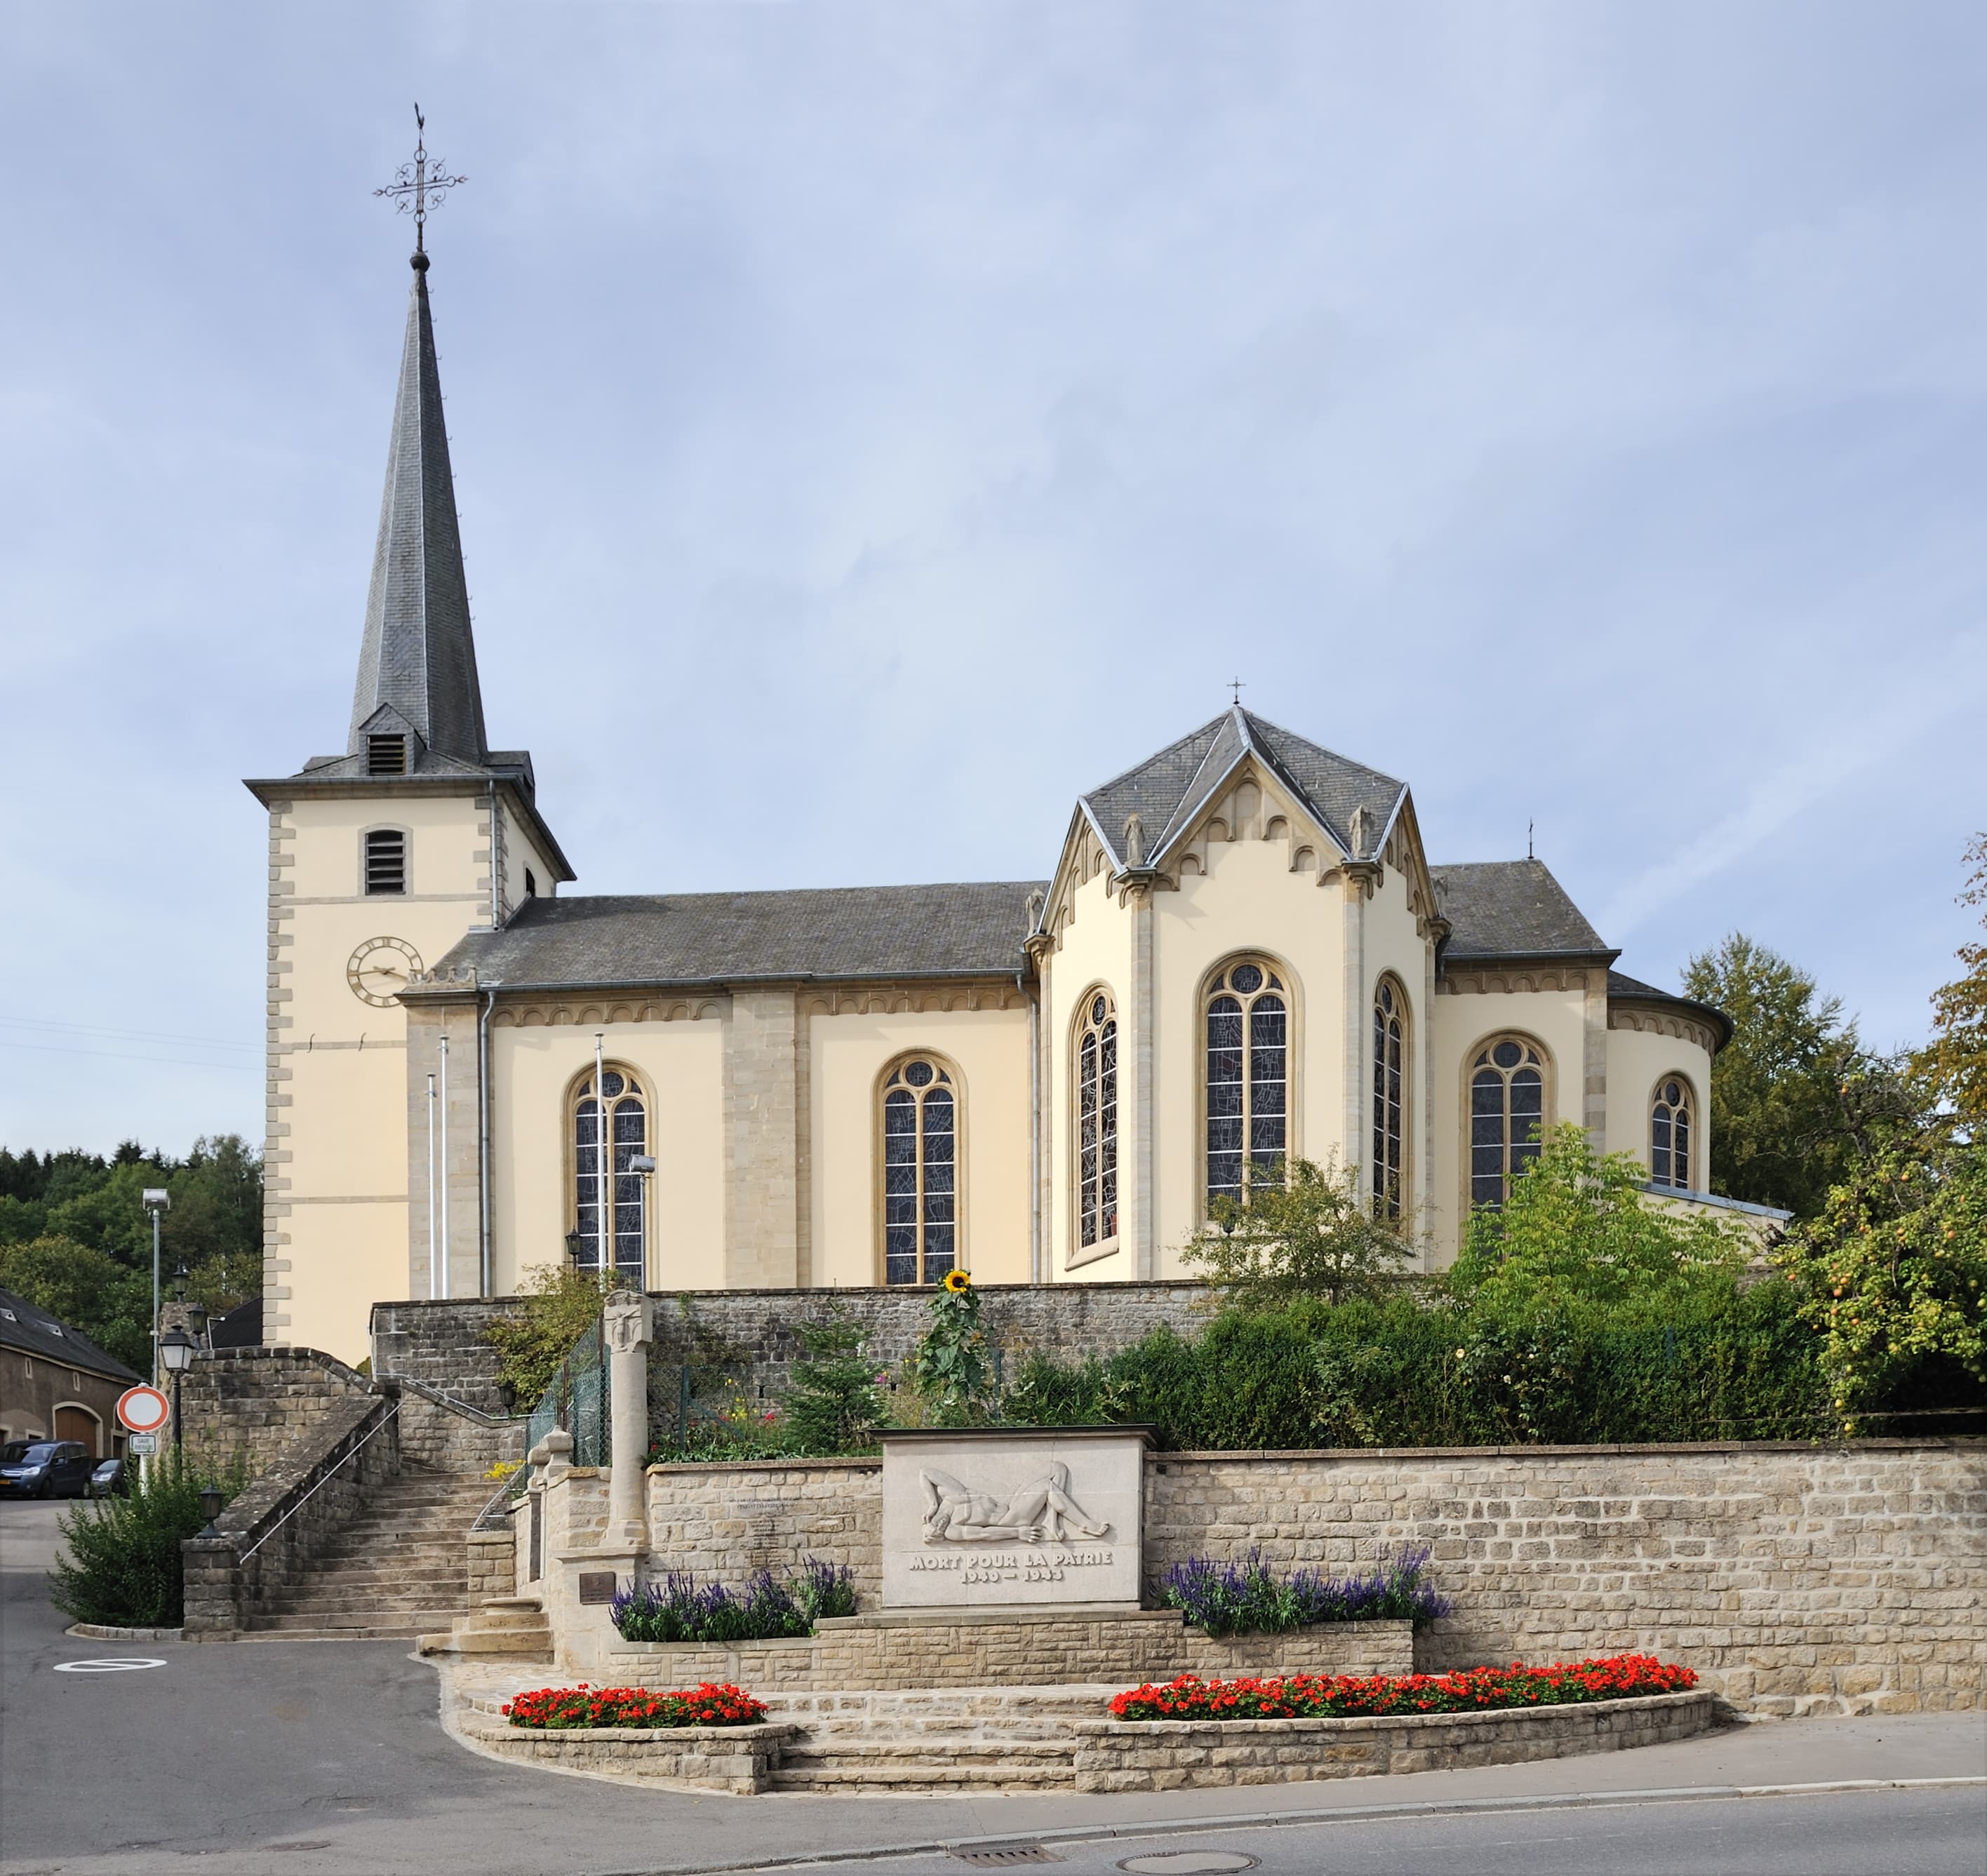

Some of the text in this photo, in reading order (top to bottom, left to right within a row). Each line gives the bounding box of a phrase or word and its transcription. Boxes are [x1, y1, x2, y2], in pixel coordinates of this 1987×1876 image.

[909, 1550, 1113, 1571] MORT POUR LA PATRIE
[960, 1570, 1000, 1584] 1940
